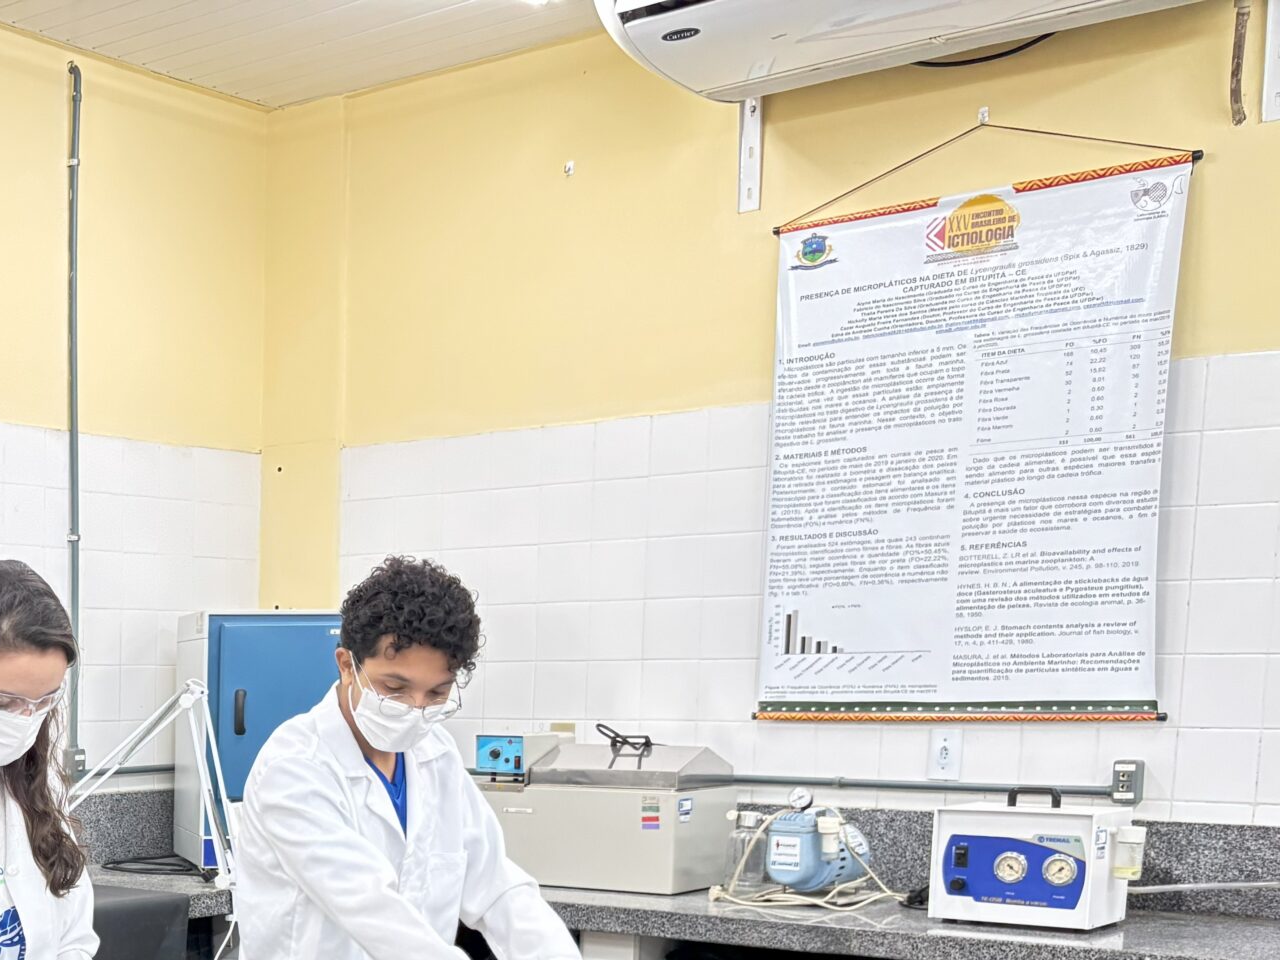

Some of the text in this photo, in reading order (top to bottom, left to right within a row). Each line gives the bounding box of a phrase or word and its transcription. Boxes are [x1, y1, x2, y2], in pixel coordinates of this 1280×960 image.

[948, 207, 1004, 233] XXV ENCONTRO
[971, 214, 1016, 229] BRASILEIRO DE
[947, 224, 1015, 249] ICTIOLOGIA
[799, 289, 839, 301] PRESENÇA
[840, 287, 851, 295] DE
[853, 276, 917, 292] MICROPLÁTICOS
[931, 270, 955, 280] DIETA
[956, 268, 968, 276] DE
[1126, 242, 1148, 252] 1829)
[902, 279, 953, 293] CAPTURADO
[954, 277, 967, 285] EM
[968, 271, 1006, 283] BITUPITÁ
[1014, 268, 1027, 276] CE
[786, 351, 835, 365] INTRODUÇÃO
[782, 450, 822, 460] MATERIAIS
[830, 446, 867, 456] MÉTODOS
[972, 487, 1025, 498] CONCLUSÃO
[778, 532, 827, 541] RESULTADOS
[835, 528, 878, 537] DISCUSSÃO
[968, 540, 1027, 550] REFERÊNCIAS
